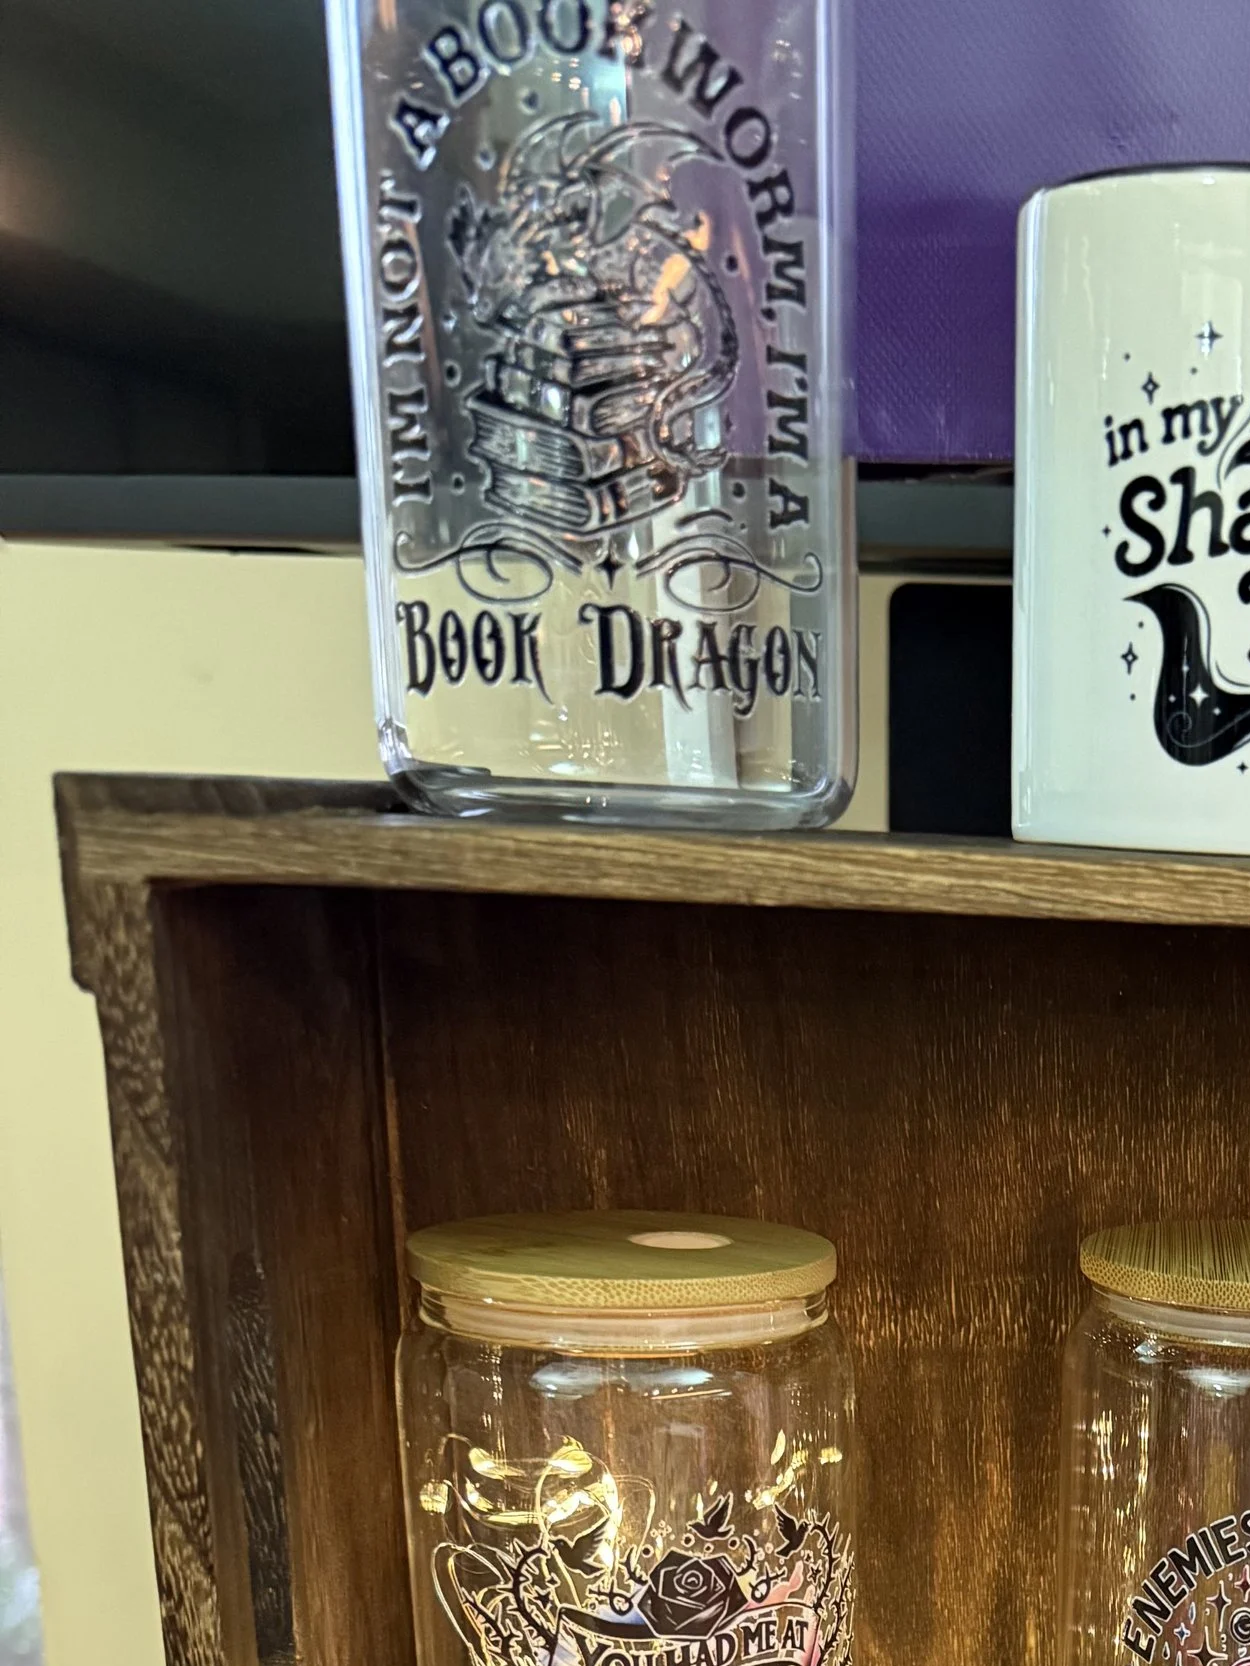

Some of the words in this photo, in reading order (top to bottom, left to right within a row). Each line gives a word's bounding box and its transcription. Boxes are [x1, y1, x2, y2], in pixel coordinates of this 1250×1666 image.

[388, 92, 450, 170] A
[766, 342, 809, 465] I'M
[1104, 414, 1149, 468] in
[1161, 394, 1244, 456] my
[768, 476, 810, 538] A
[396, 600, 555, 706] BOOK
[577, 602, 822, 720] DRAGON
[740, 1615, 777, 1659] ME
[780, 1617, 812, 1653] AT
